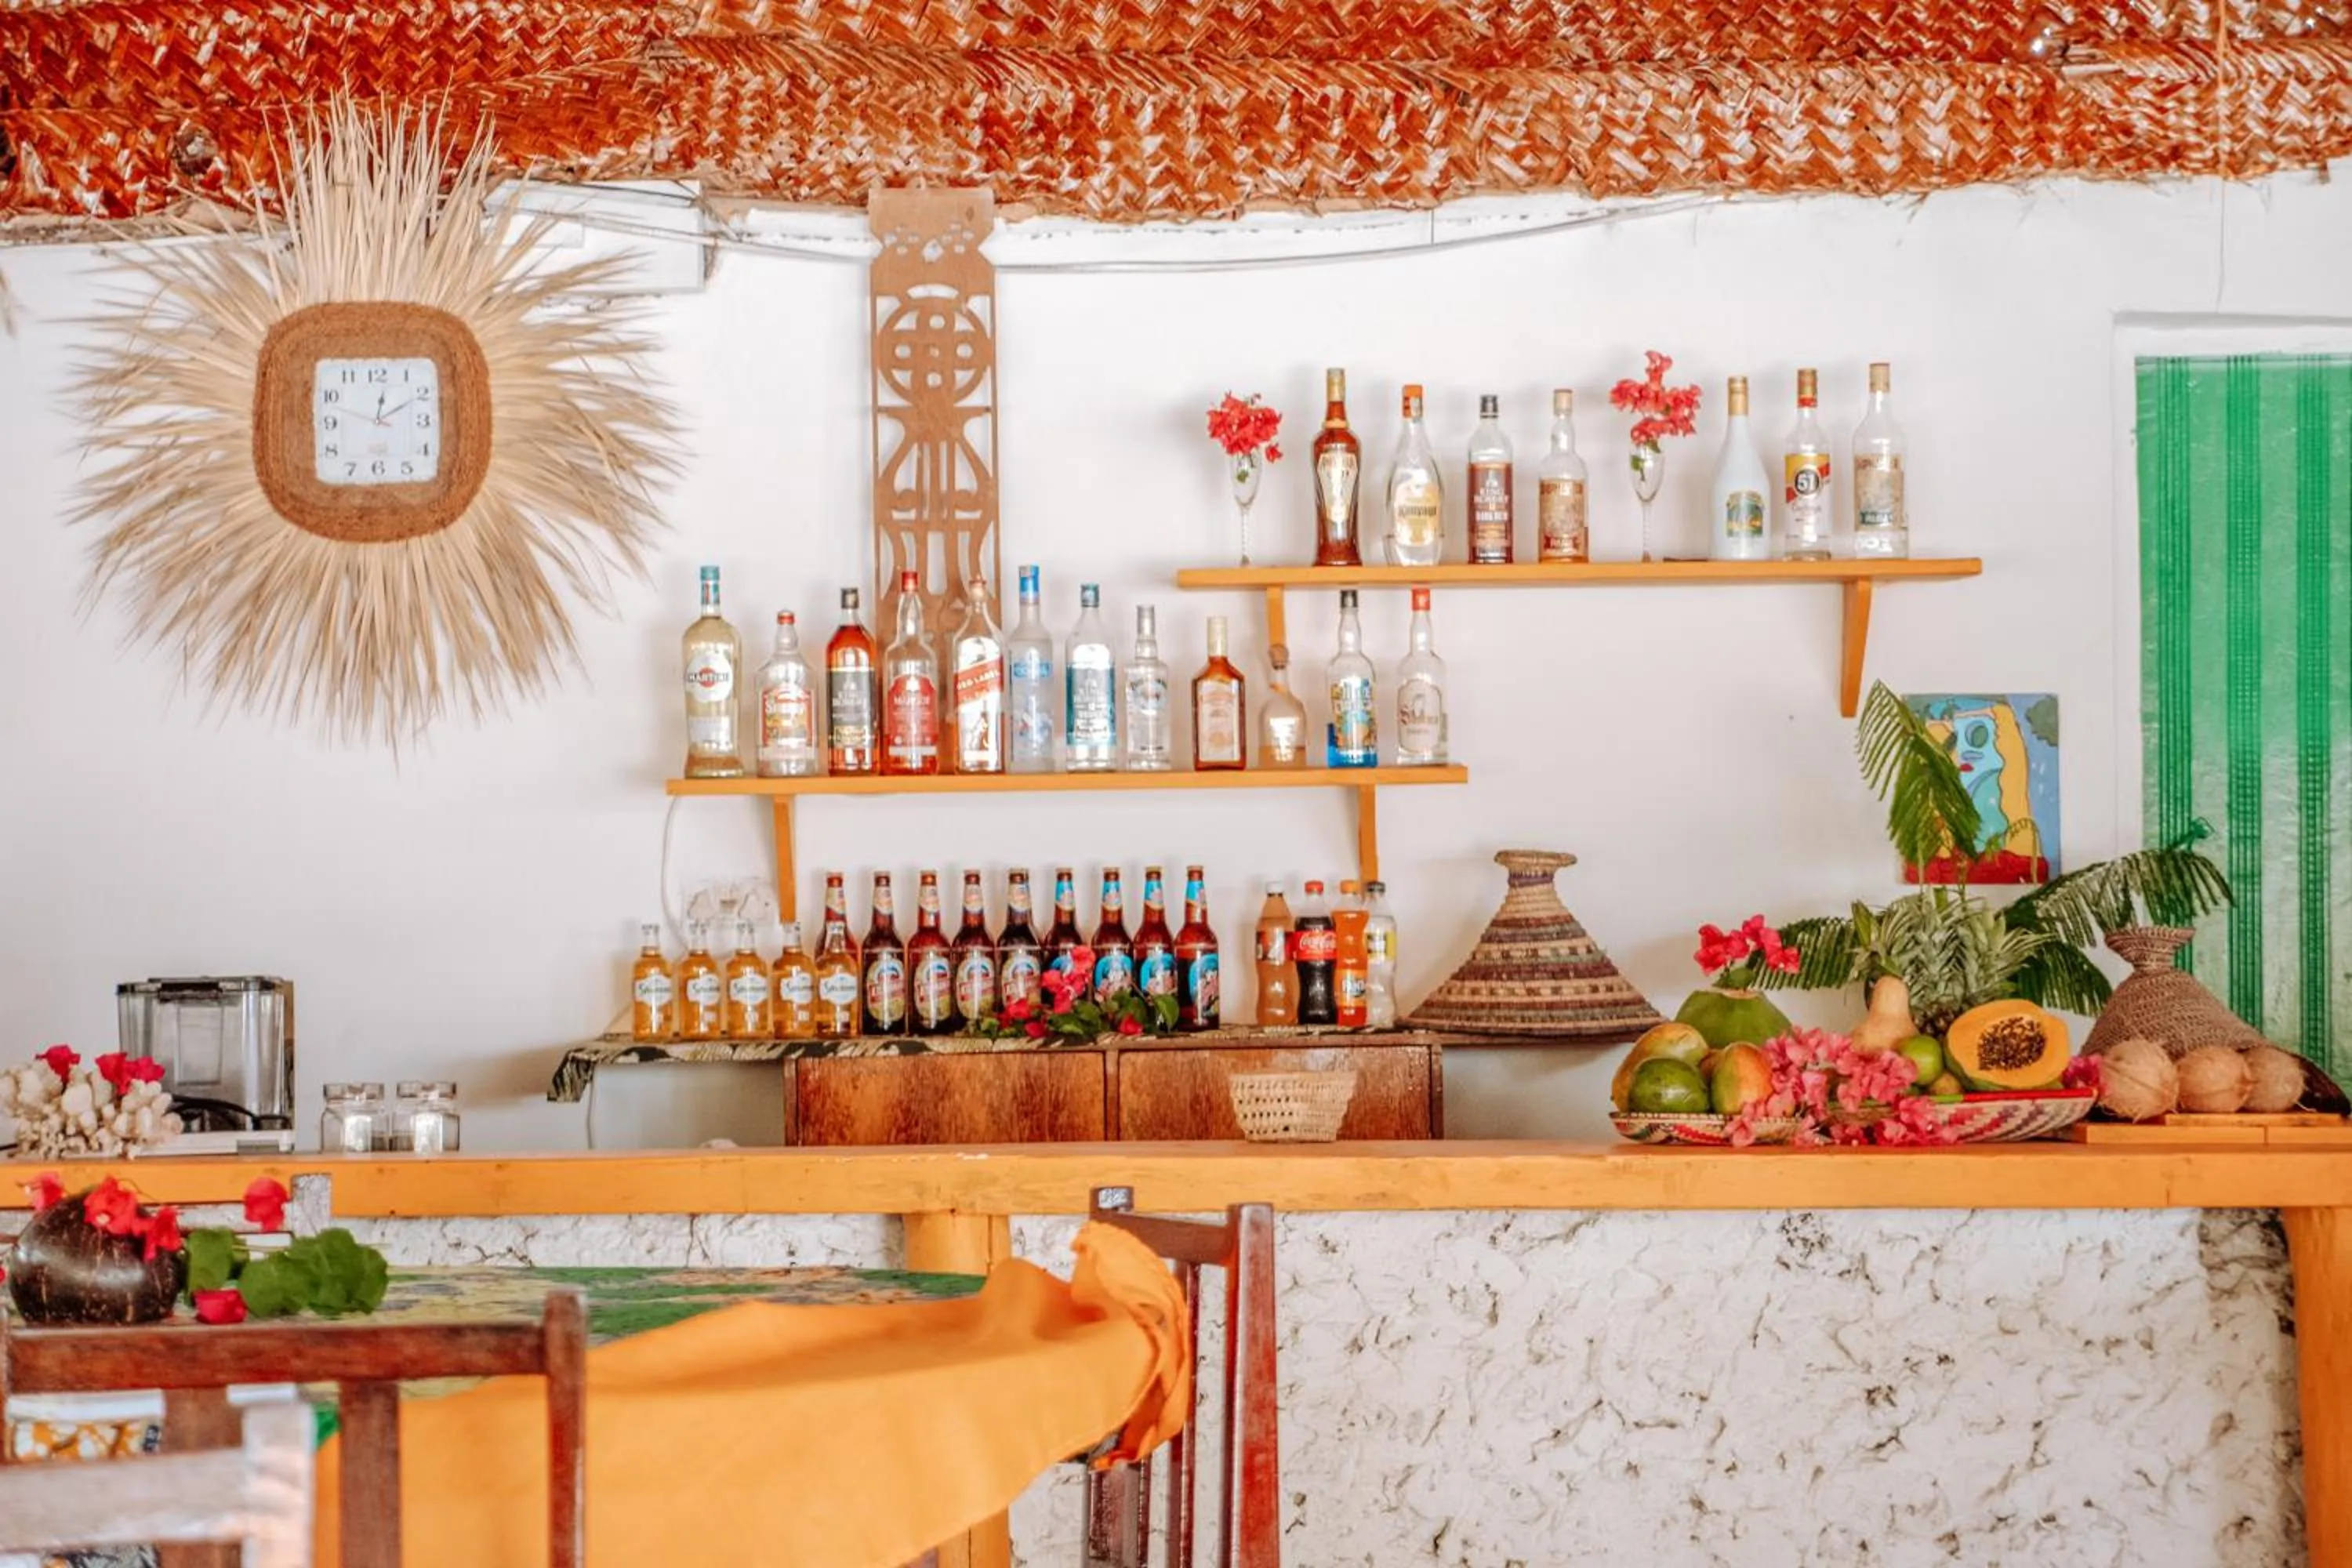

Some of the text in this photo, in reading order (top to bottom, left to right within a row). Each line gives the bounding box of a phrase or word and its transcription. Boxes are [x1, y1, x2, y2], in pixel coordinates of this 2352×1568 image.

[342, 369, 355, 383] 11
[367, 368, 387, 383] 12
[404, 369, 409, 383] 1
[324, 389, 339, 403] 10
[416, 387, 430, 401] 2
[324, 416, 337, 430] 9
[416, 413, 430, 428] 3
[325, 443, 338, 458] 8
[416, 443, 429, 456] 4
[343, 461, 357, 477] 7
[372, 460, 386, 476] 6
[401, 461, 414, 474] 5
[1797, 473, 1815, 492] 51
